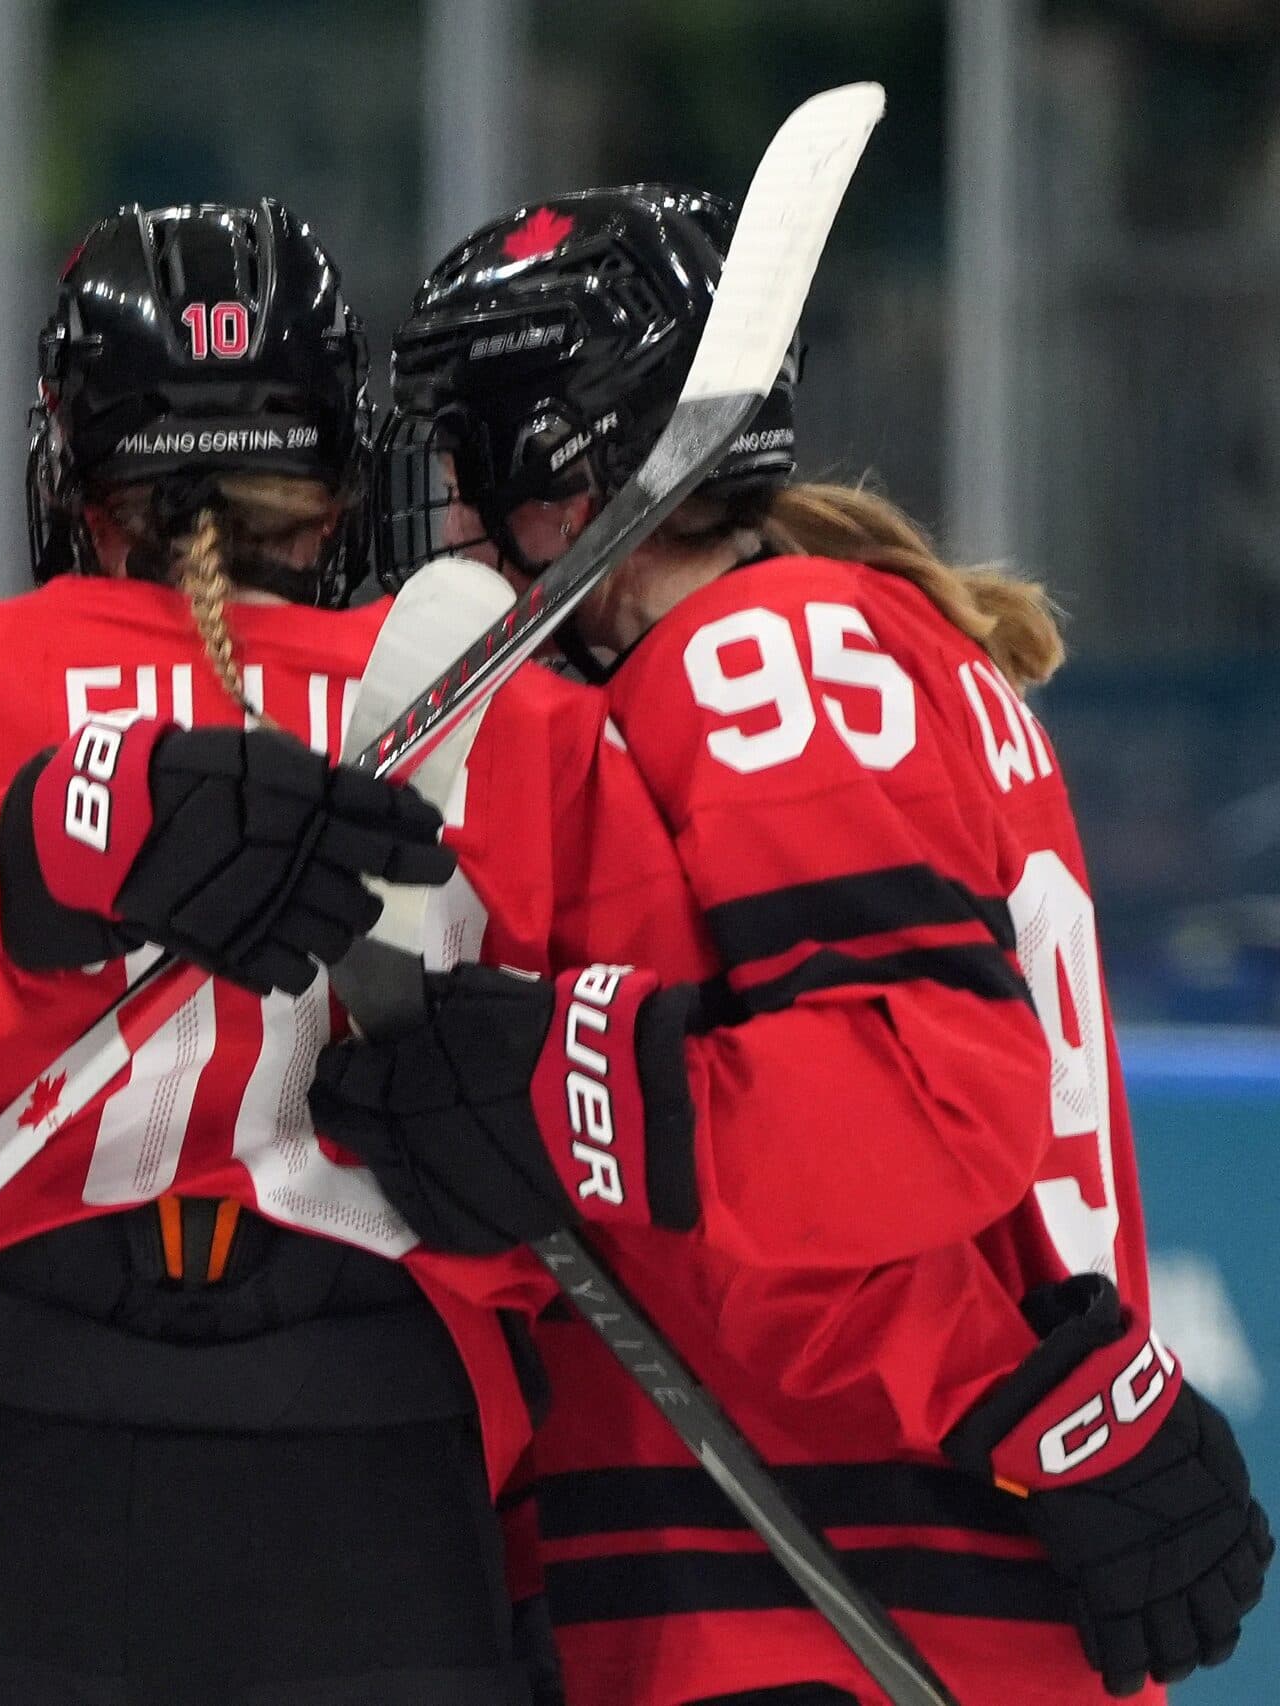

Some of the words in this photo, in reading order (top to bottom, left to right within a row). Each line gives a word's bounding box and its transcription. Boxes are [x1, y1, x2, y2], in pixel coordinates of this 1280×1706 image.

[181, 302, 249, 360] 10
[115, 433, 195, 454] MILANO
[197, 429, 284, 453] CORTINA
[682, 601, 917, 774] 95
[540, 1233, 691, 1406] LYLITE
